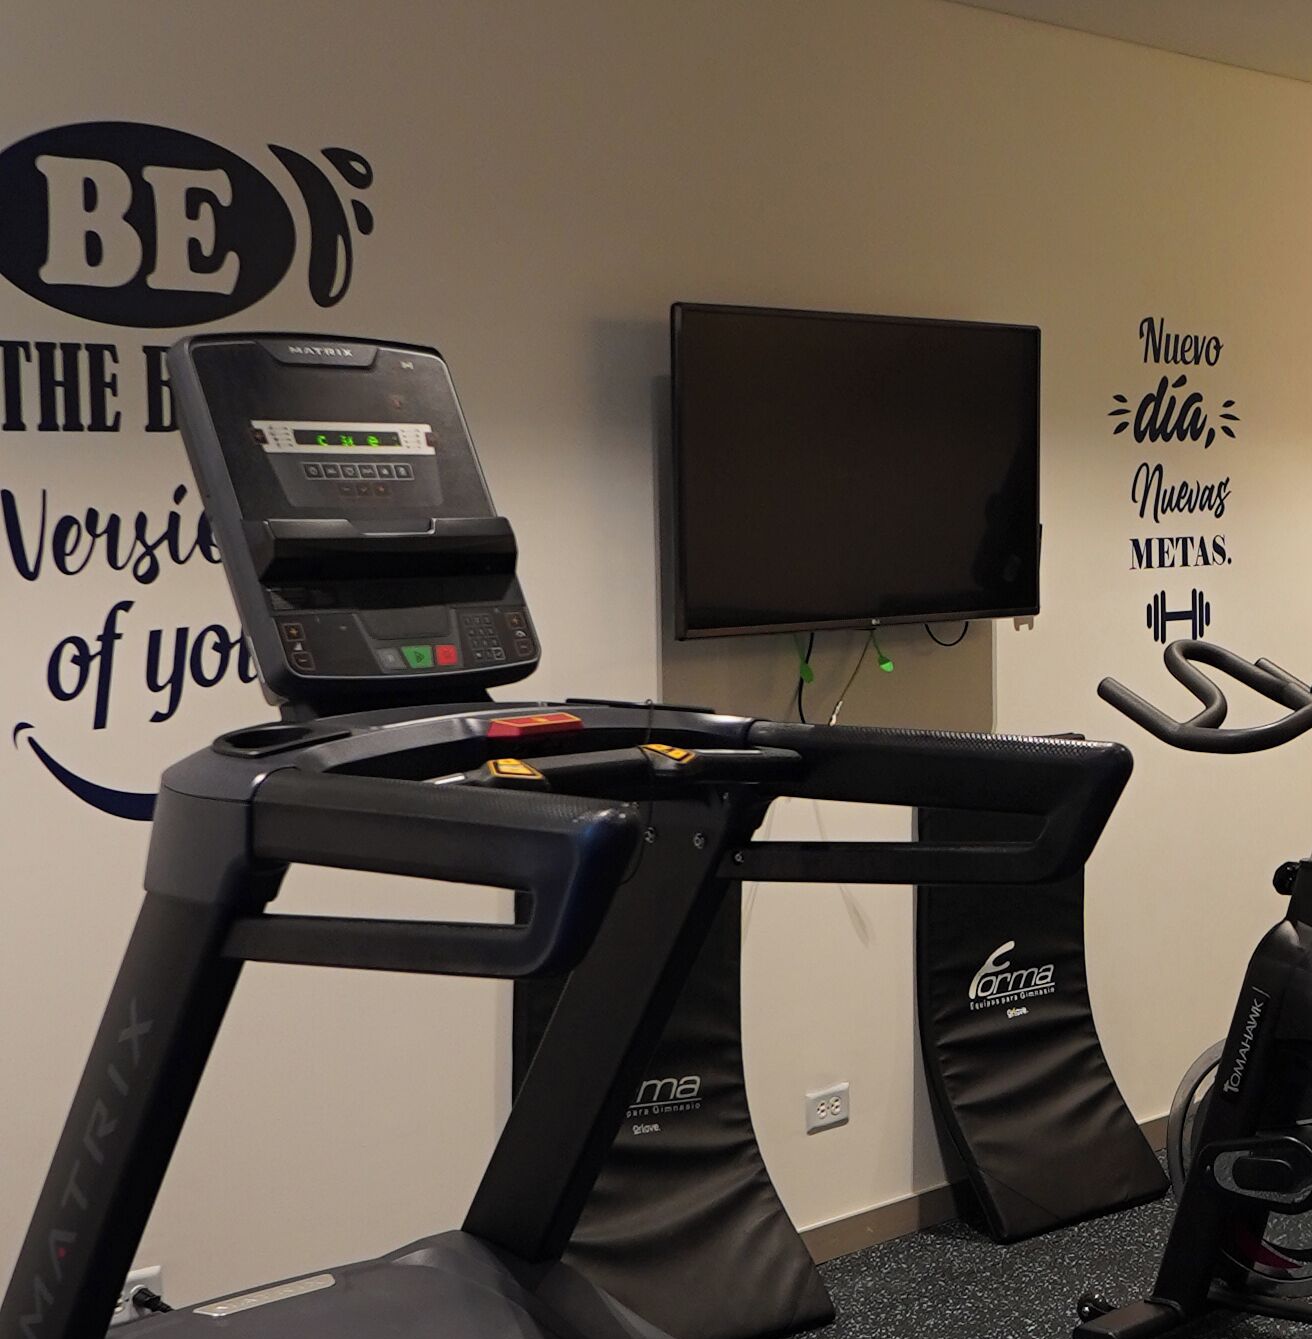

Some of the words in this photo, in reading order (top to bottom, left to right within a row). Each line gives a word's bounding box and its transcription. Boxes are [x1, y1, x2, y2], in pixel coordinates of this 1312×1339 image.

[35, 154, 241, 296] BE
[288, 346, 353, 358] MATRIX
[1139, 316, 1223, 366] Nuevo
[0, 340, 121, 432] THE
[1133, 374, 1216, 449] día,
[1131, 462, 1231, 523] Nuevas
[1129, 534, 1232, 570] METAS.
[47, 600, 135, 730] of
[968, 940, 1054, 999] Forma
[1223, 998, 1264, 1092] TOMAHAWK
